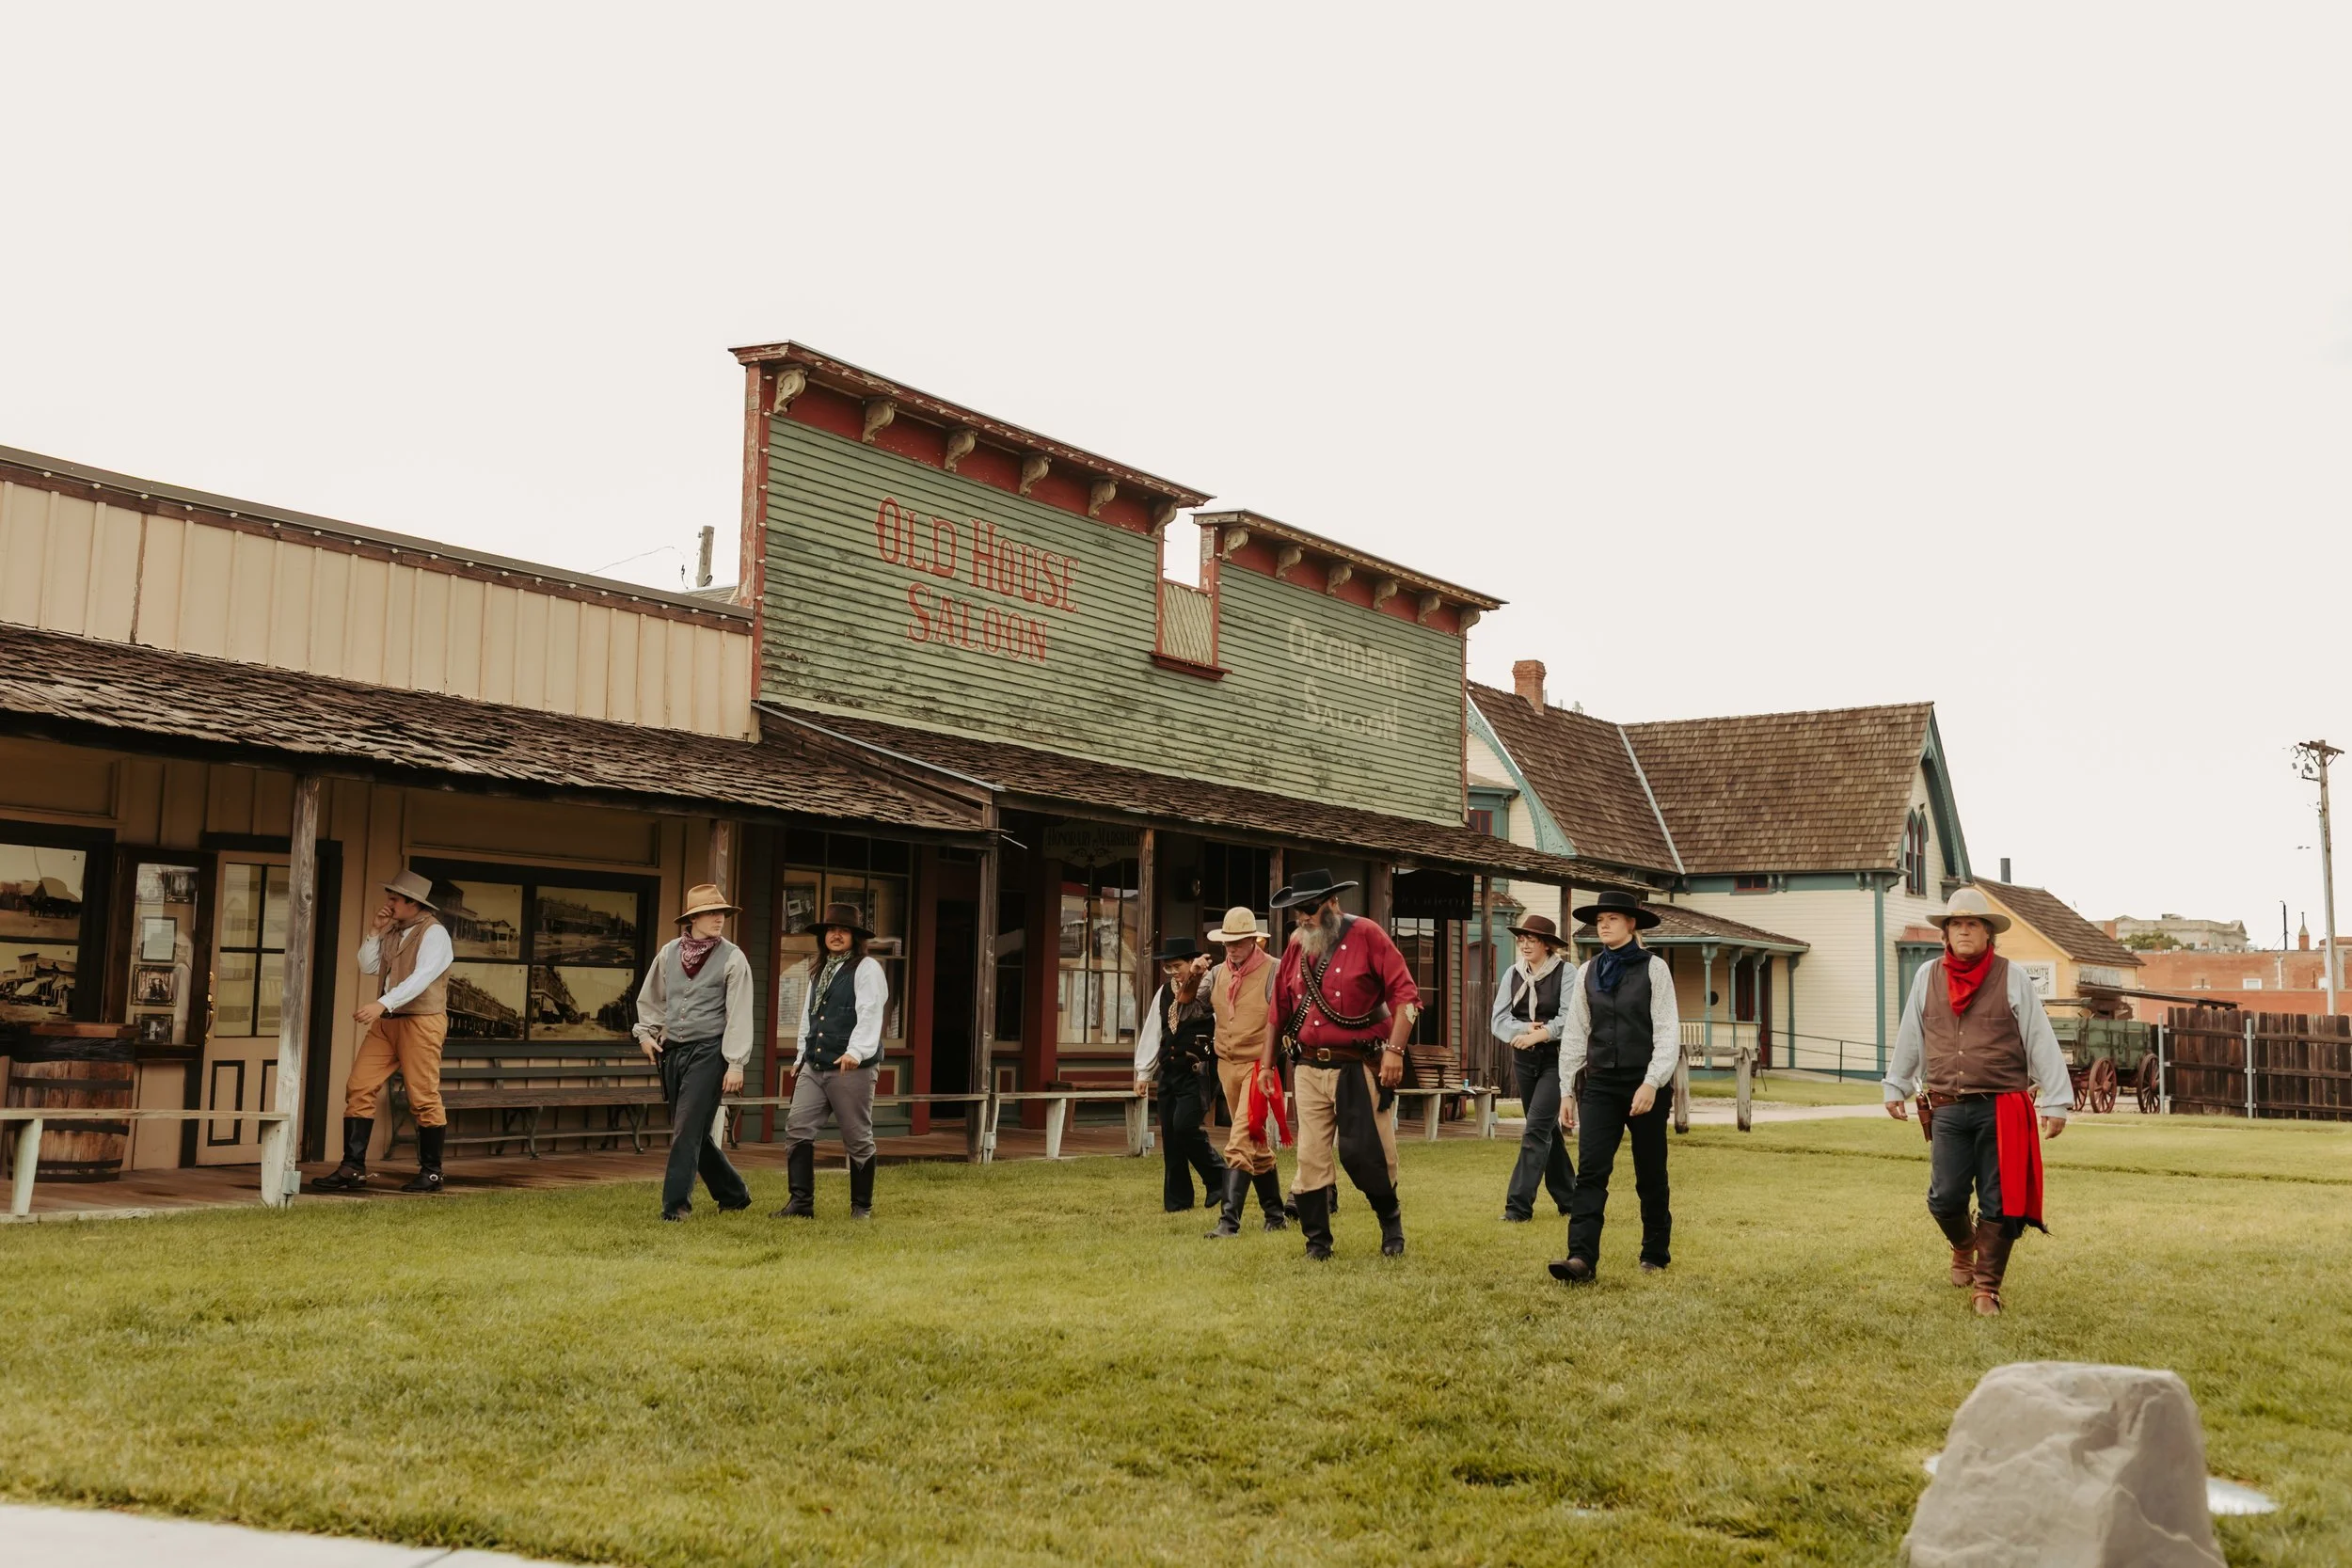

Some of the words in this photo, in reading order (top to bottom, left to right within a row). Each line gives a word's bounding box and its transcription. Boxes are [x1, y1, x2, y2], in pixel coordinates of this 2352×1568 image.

[873, 496, 958, 579] OLD
[969, 517, 1080, 615] HOUSE
[905, 581, 1049, 663] SALOON
